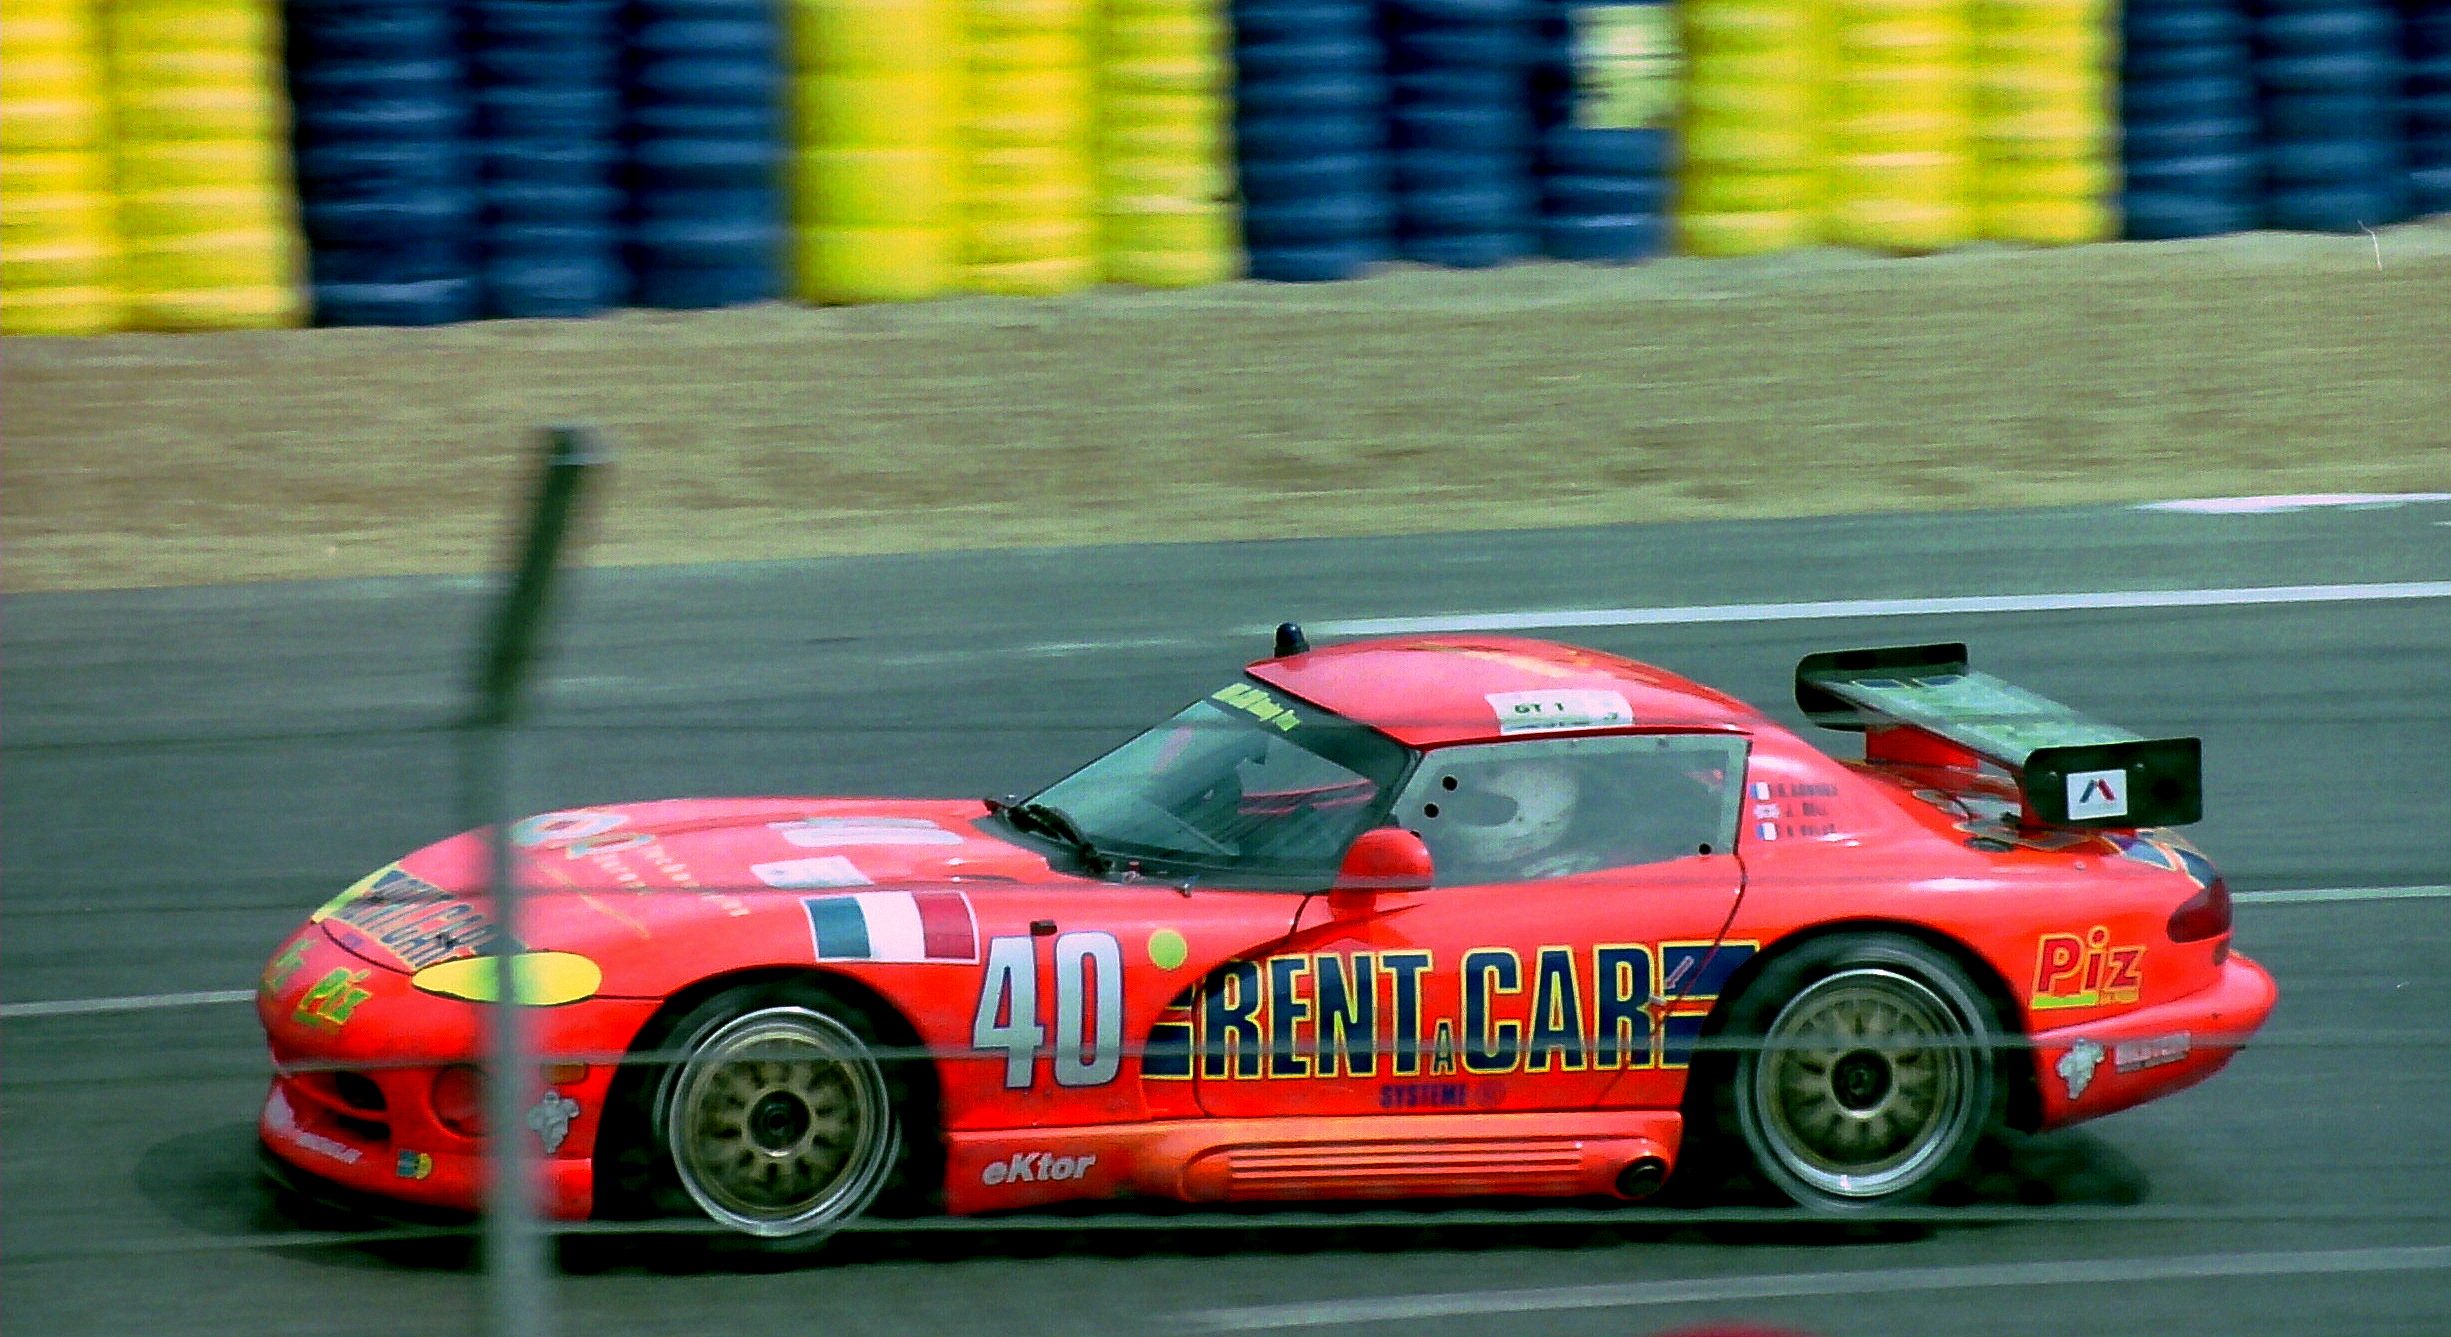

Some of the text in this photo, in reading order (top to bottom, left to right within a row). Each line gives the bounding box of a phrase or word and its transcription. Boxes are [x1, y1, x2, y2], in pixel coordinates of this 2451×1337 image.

[1514, 703, 1541, 714] GT
[2032, 925, 2147, 998] Piz
[973, 931, 1124, 1089] 40
[1201, 944, 1657, 1080] RENT A CAR
[982, 1151, 1096, 1186] eKtor
